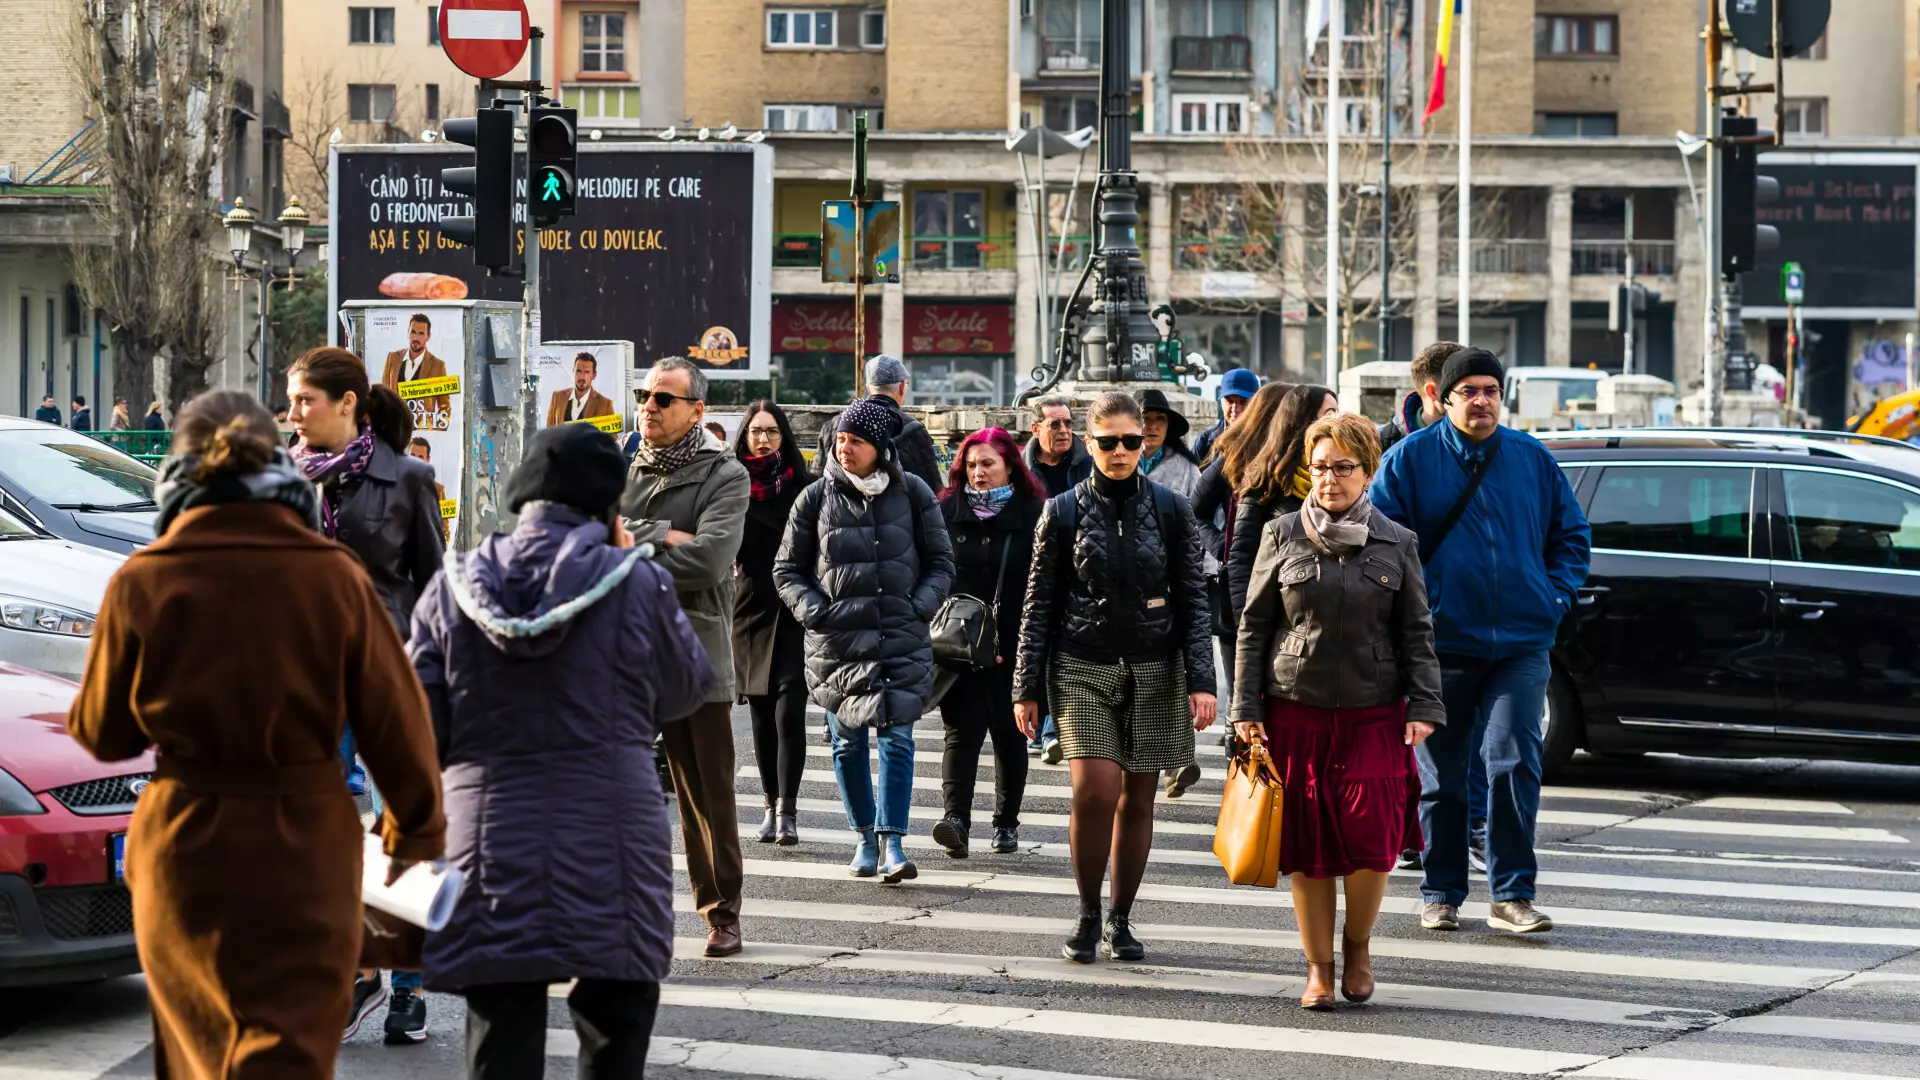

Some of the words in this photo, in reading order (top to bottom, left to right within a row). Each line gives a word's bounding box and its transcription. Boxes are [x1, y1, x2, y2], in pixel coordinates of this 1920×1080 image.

[370, 174, 408, 198] CÂND
[577, 177, 638, 199] MELODIEI
[645, 178, 661, 198] PE
[668, 177, 701, 198] CARE
[370, 203, 380, 222] O
[403, 230, 410, 249] E
[580, 230, 597, 249] CU
[603, 229, 667, 251] DOVLEAC.
[443, 383, 457, 391] 19:30
